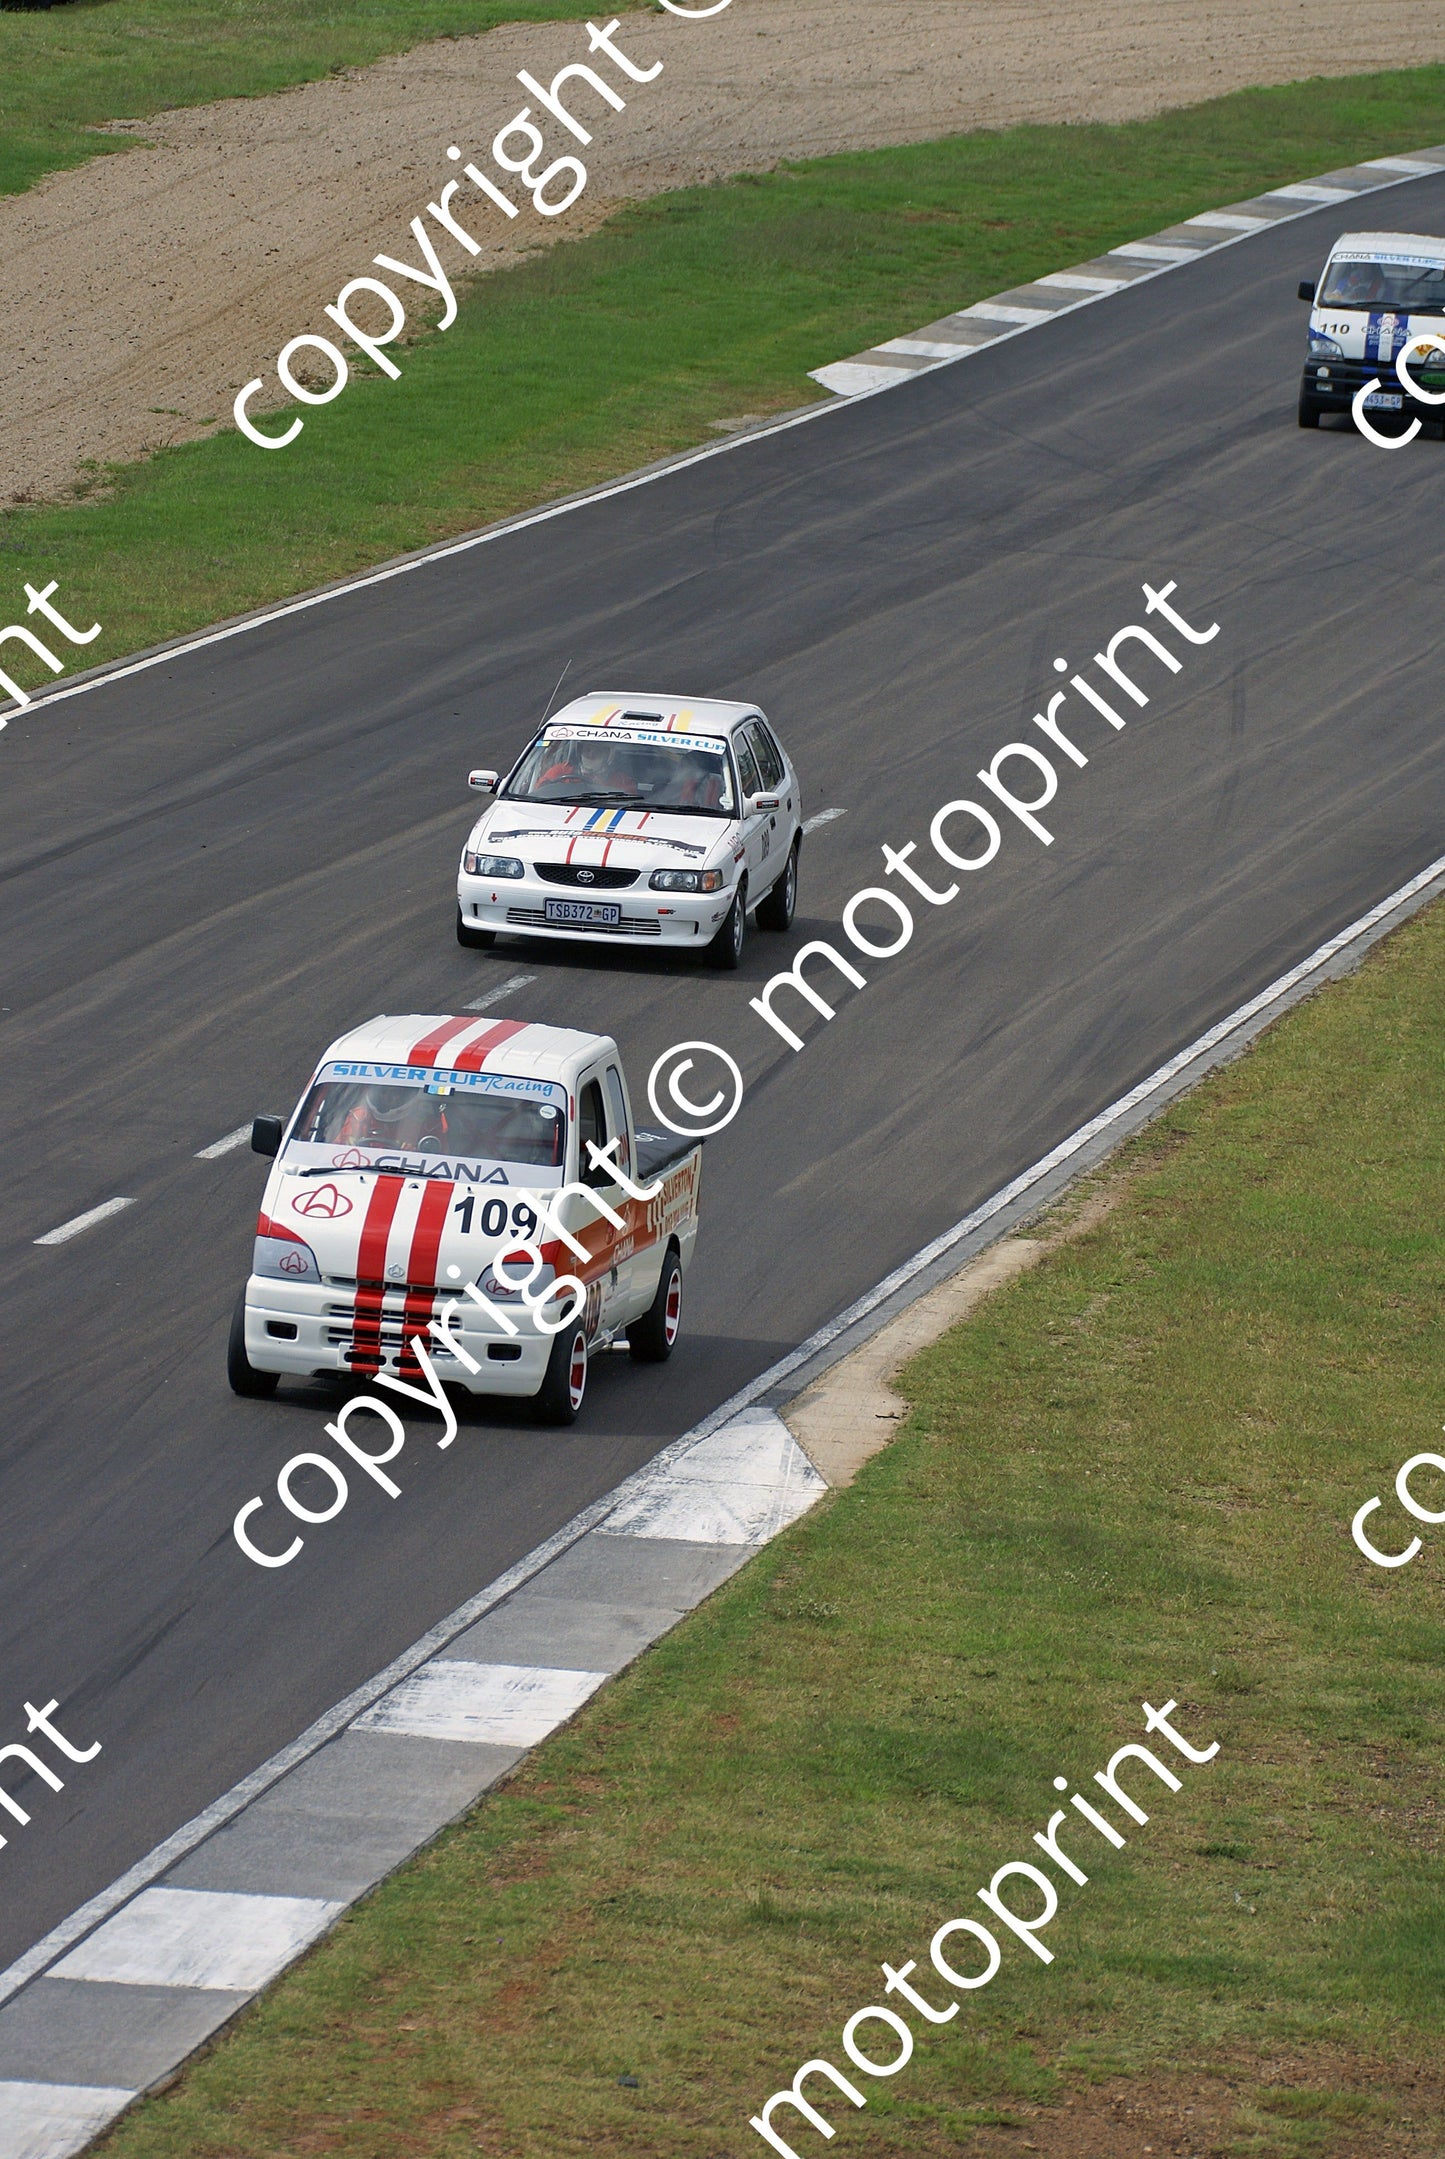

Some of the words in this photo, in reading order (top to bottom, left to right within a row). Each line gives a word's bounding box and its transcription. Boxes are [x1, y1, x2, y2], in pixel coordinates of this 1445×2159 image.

[1320, 323, 1350, 335] 110
[1361, 325, 1412, 337] CHANA
[576, 730, 632, 740] CHANA
[637, 733, 692, 746] SILVER
[695, 740, 726, 751] CUP
[548, 903, 593, 920] TSB372
[602, 908, 617, 921] GP
[333, 1064, 426, 1081] SILVER
[433, 1071, 489, 1086] CUP
[485, 1076, 554, 1097] Racing
[374, 1155, 509, 1186] CHANA
[454, 1196, 538, 1241] 109
[613, 1235, 635, 1263] CHANA
